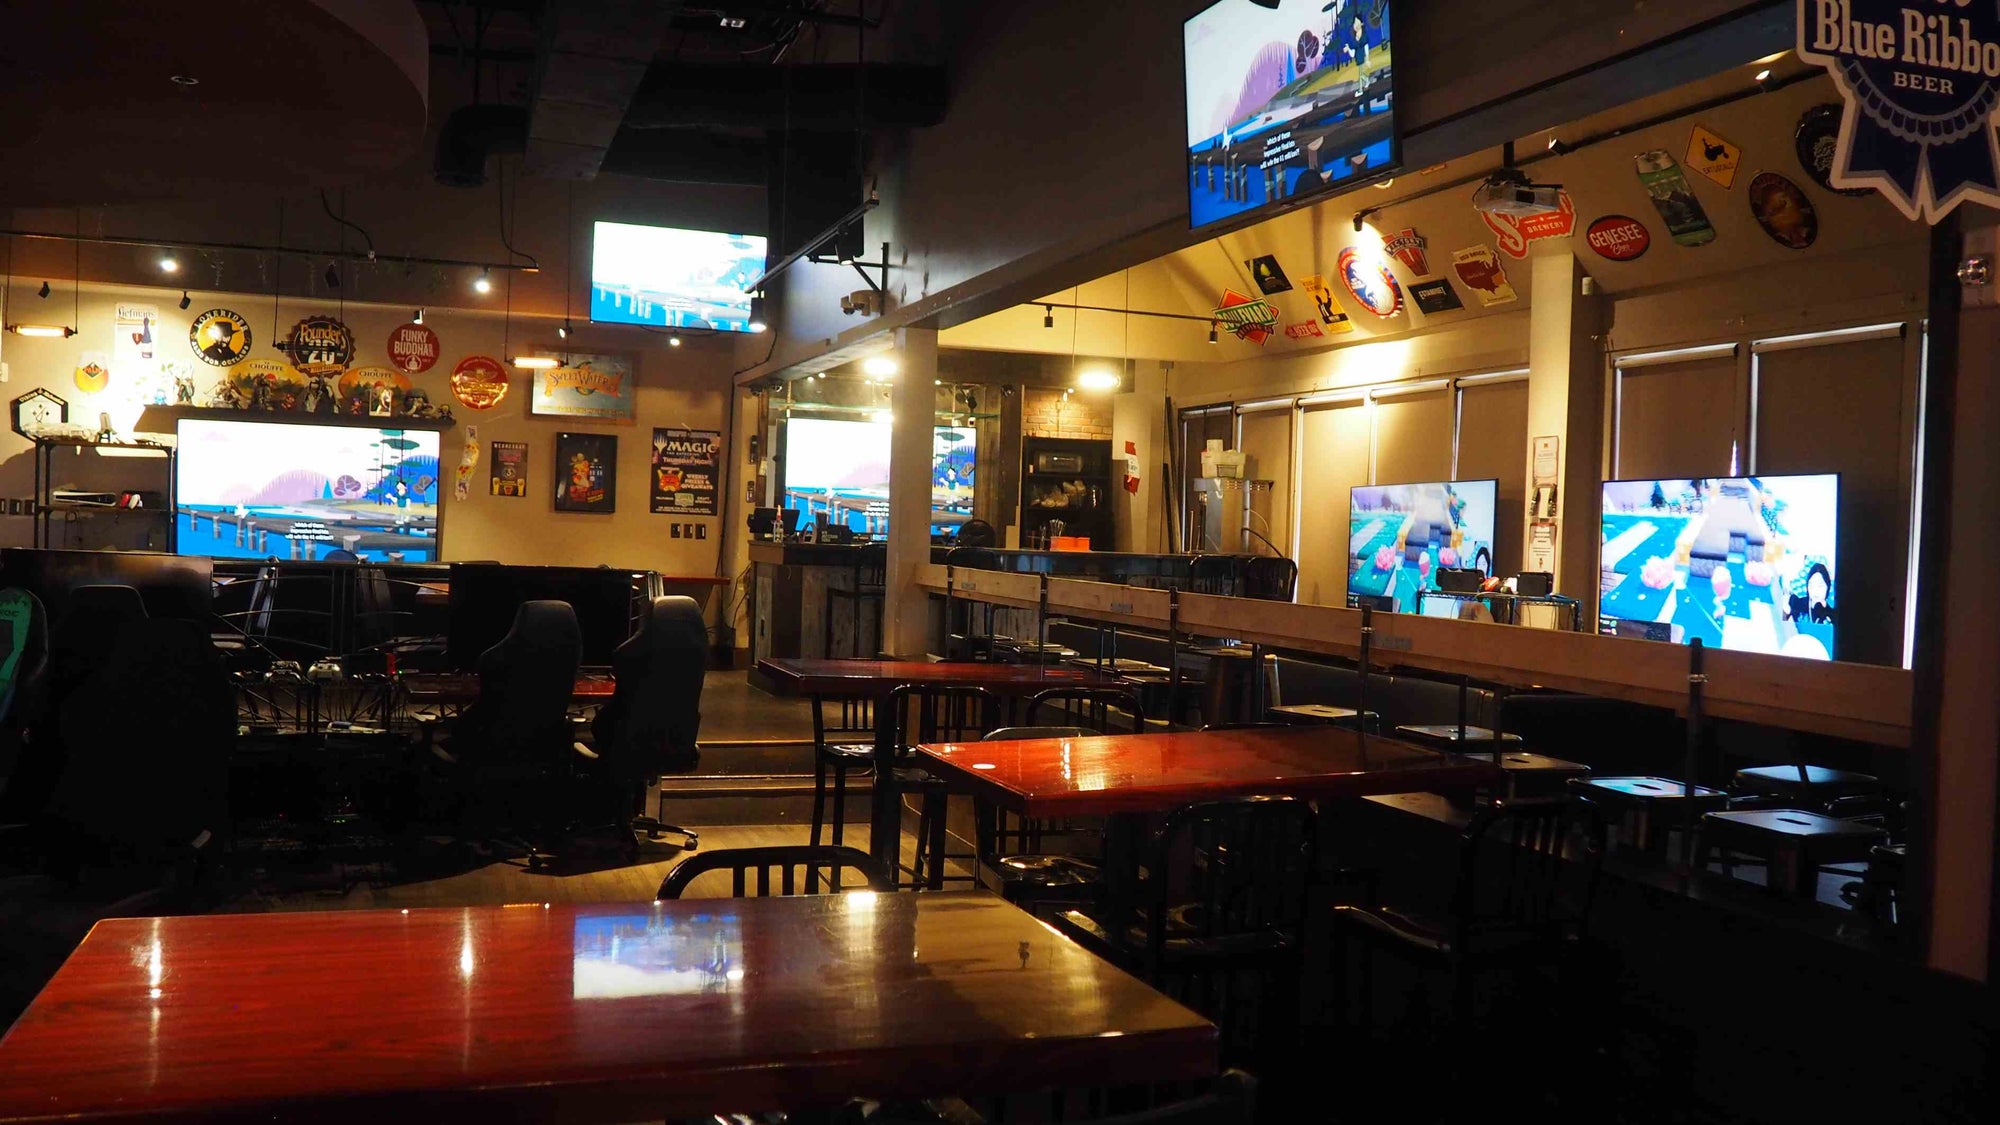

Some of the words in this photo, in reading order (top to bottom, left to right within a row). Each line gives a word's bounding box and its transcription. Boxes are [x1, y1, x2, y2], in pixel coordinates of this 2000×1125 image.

[1813, 0, 1895, 60] Blue
[1893, 71, 1954, 95] BEER
[1526, 221, 1565, 233] BREWERY
[1590, 223, 1642, 249] GENESEE
[400, 329, 429, 343] FUNKY
[394, 341, 434, 358] BUDDHA
[666, 441, 717, 453] MAGIC
